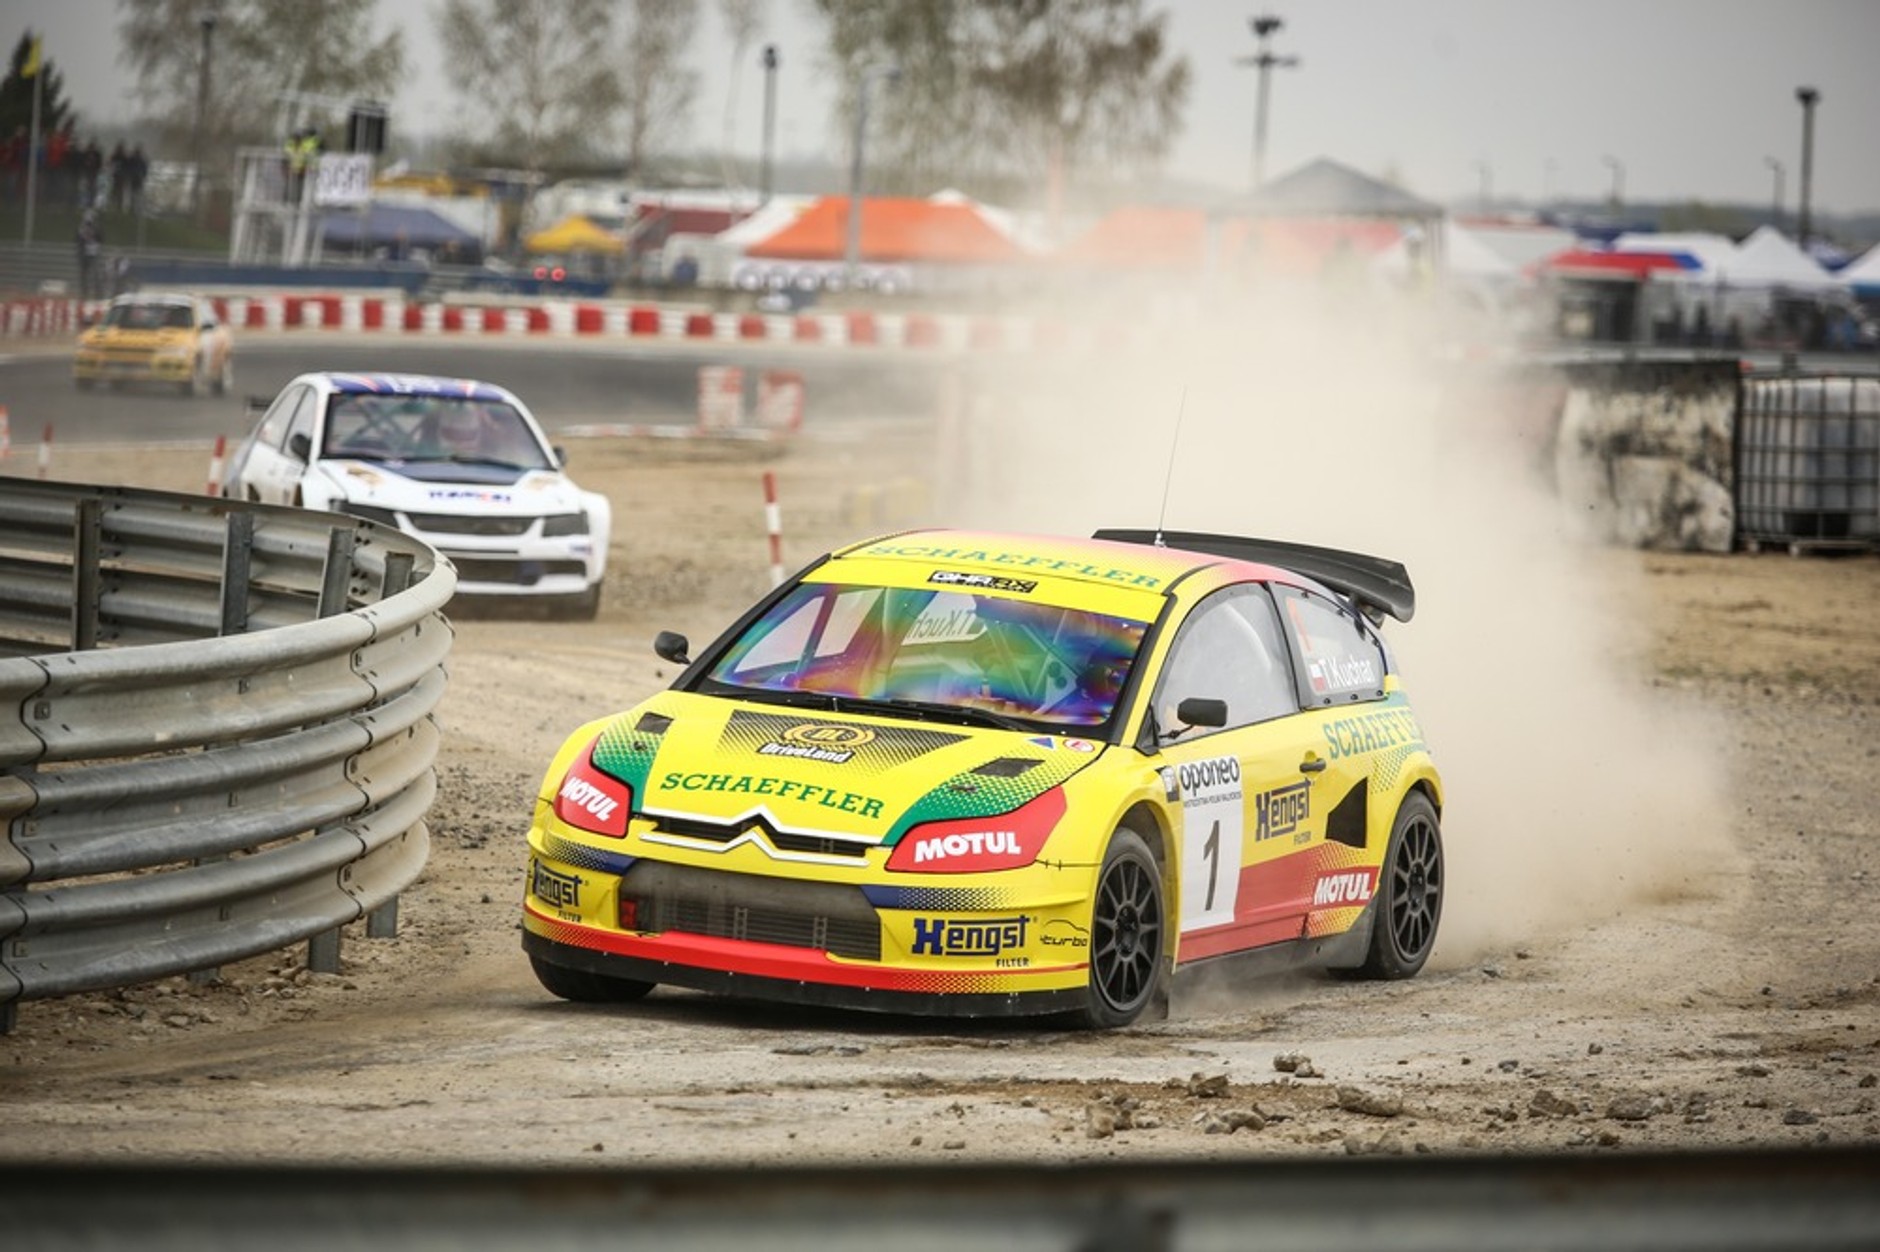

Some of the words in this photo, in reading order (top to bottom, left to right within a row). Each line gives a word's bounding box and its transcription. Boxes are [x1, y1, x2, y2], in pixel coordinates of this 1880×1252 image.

[867, 546, 1160, 588] SCHAEFFLER
[660, 773, 884, 819] SCHAEFFLER
[1180, 757, 1240, 797] oponeo
[559, 776, 619, 822] MOTUL
[1256, 777, 1311, 842] Hengst
[914, 832, 1021, 863] MOTUL
[1203, 820, 1220, 911] 1
[1314, 873, 1371, 905] MOTUL
[912, 914, 1030, 956] Hengst
[995, 957, 1030, 968] FILTER
